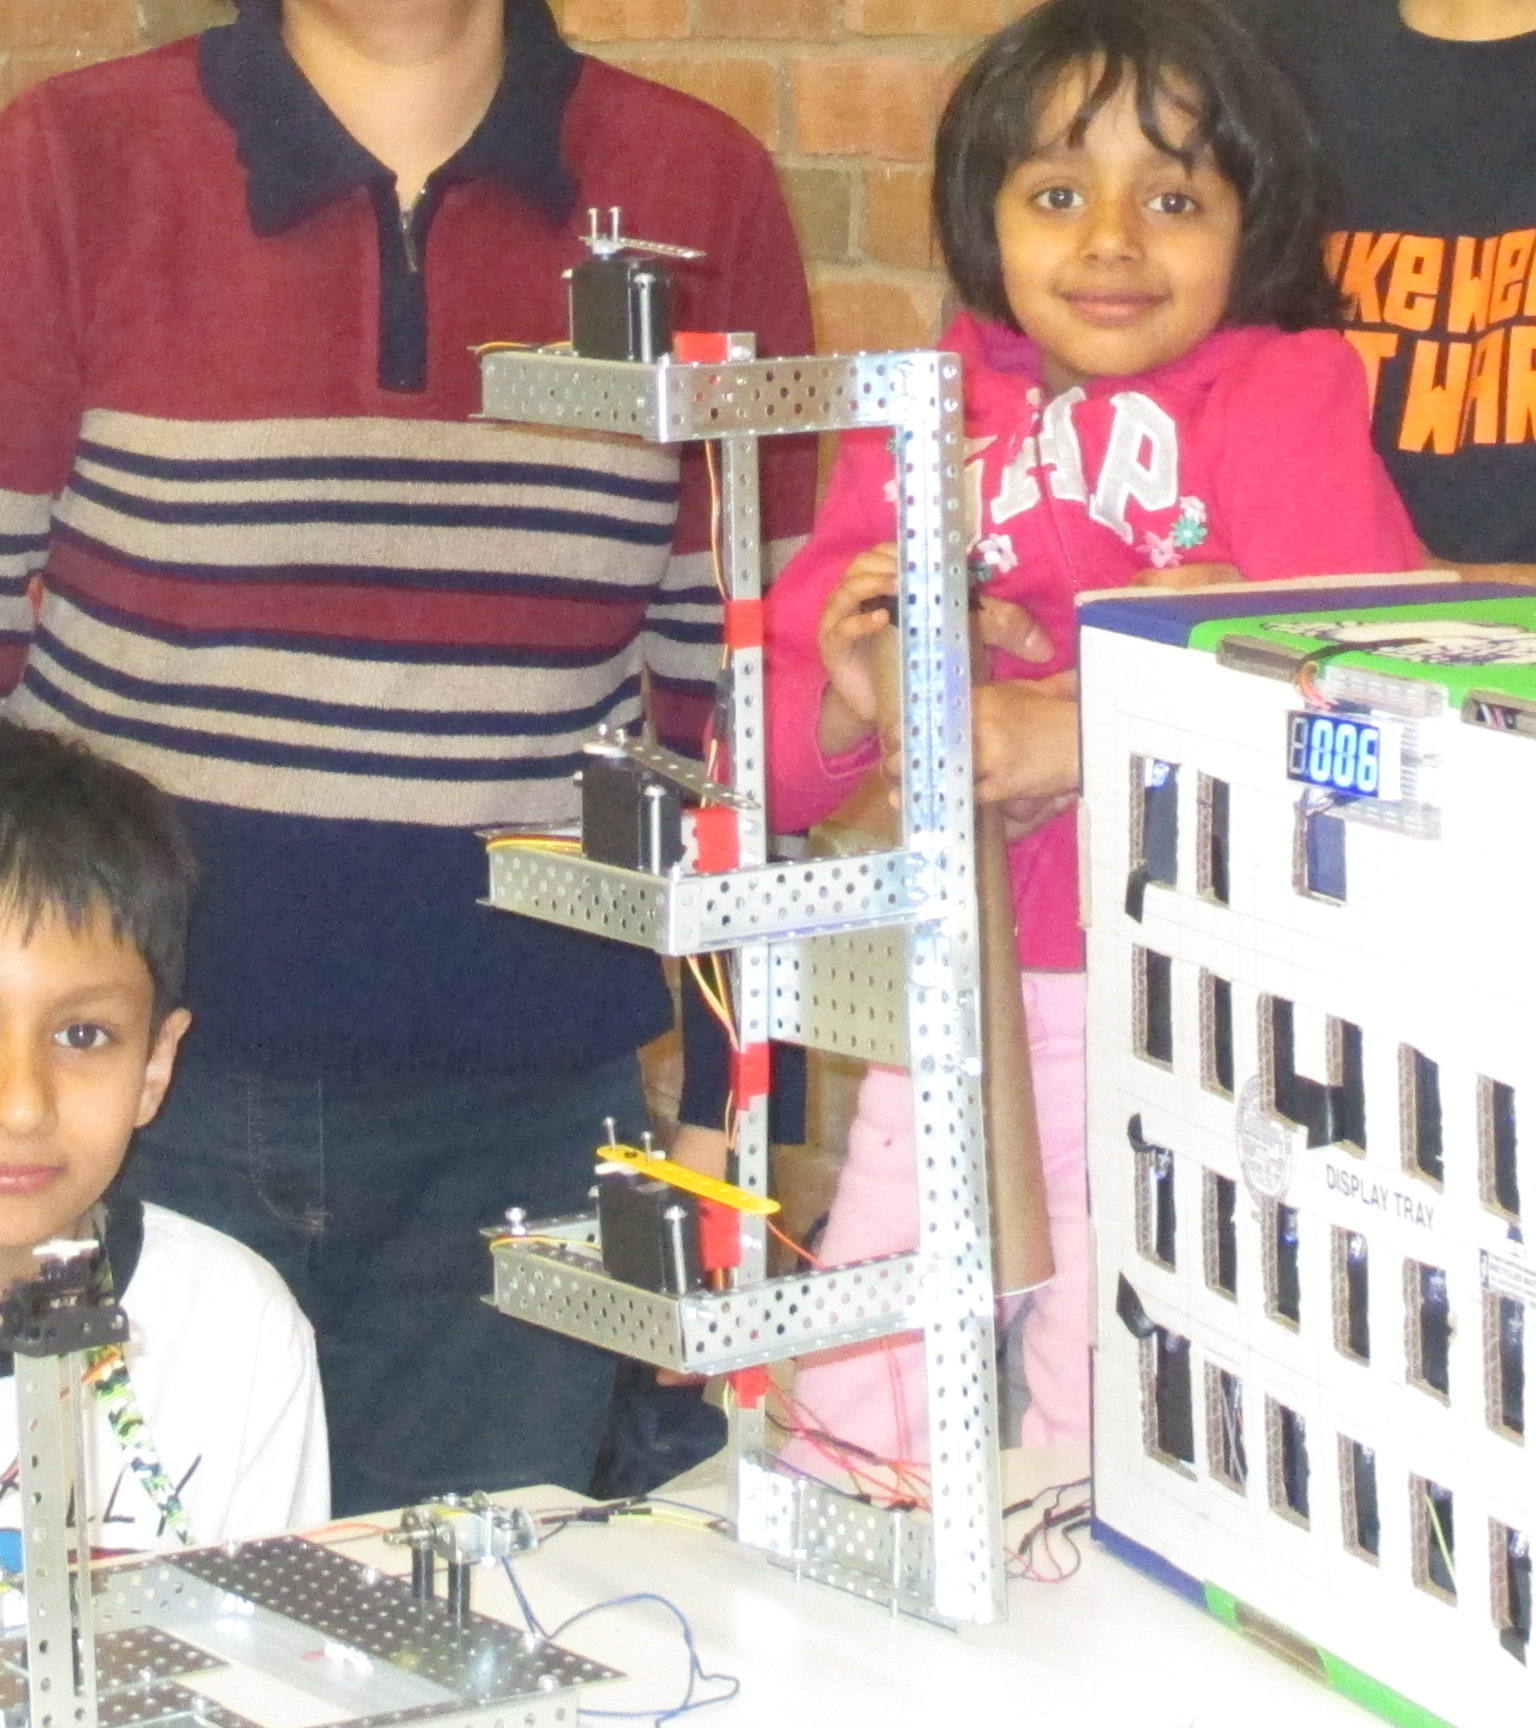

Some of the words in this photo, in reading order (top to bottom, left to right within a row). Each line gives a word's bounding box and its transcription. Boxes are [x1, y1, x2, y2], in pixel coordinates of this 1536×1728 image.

[963, 386, 1179, 554] AP
[1326, 1162, 1389, 1212] DISPLAY
[1393, 1190, 1435, 1231] TRAY
